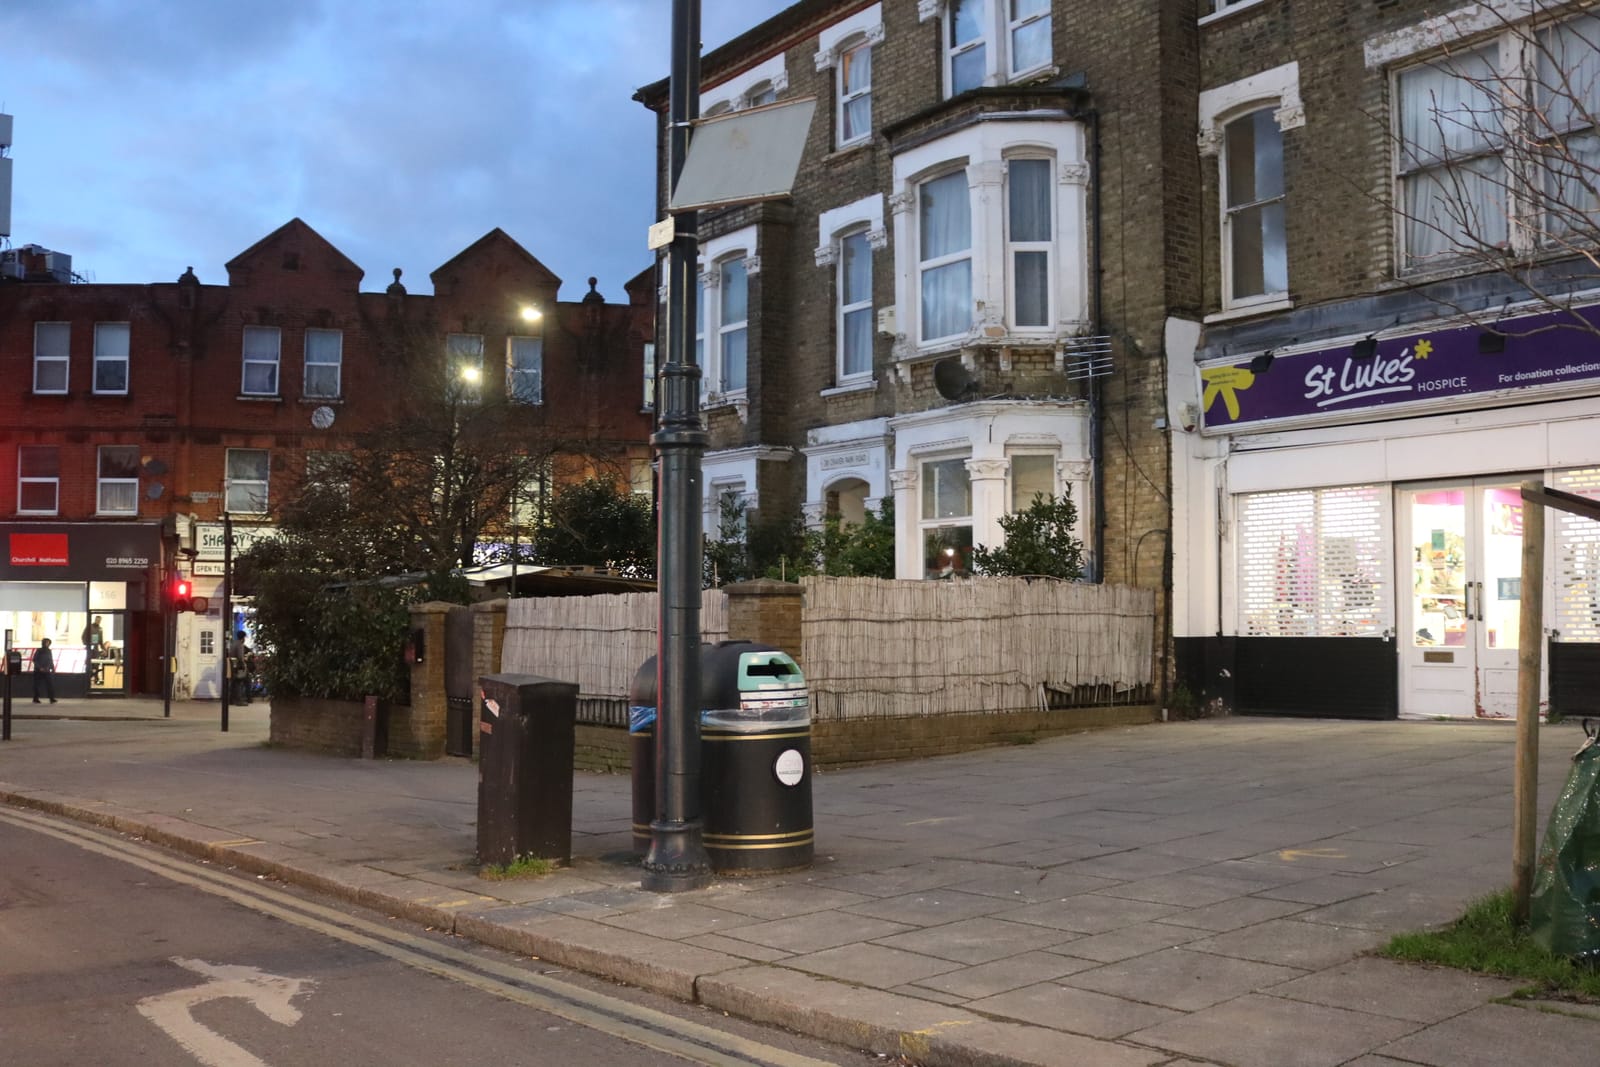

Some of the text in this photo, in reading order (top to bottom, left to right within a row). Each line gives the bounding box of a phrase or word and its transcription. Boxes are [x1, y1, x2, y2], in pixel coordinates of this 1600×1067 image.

[1304, 347, 1467, 399] St Luke's HOSPICE
[1498, 374, 1513, 383] For
[1514, 368, 1553, 381] donation
